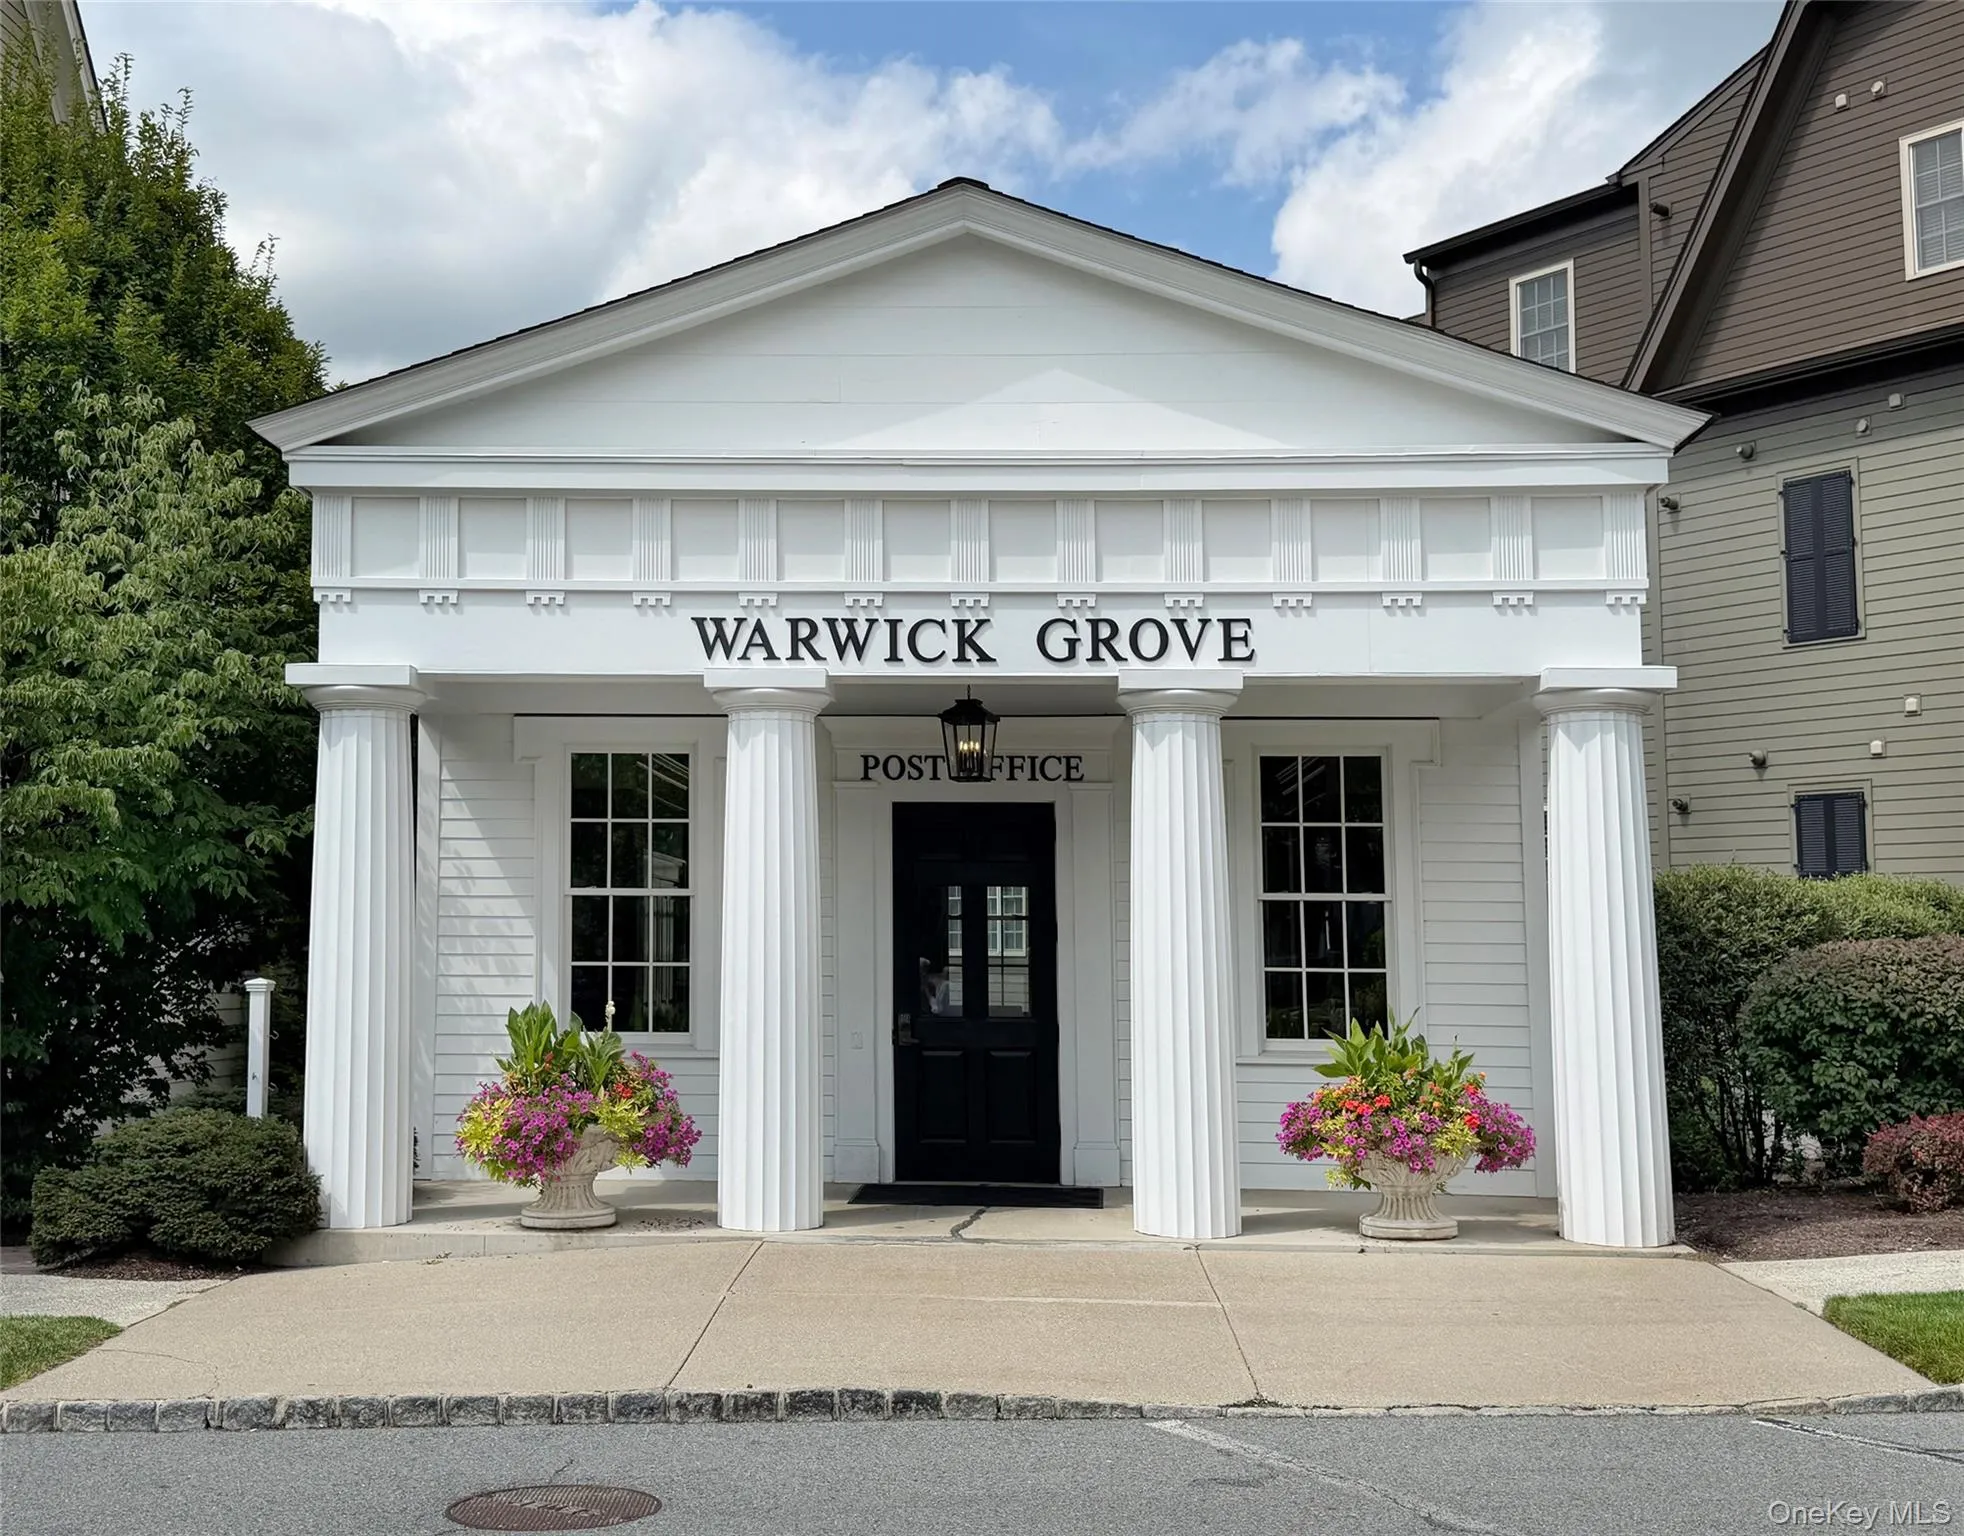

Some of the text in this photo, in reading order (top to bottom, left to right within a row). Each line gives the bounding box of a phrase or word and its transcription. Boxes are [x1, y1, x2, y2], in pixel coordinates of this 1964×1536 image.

[691, 617, 1255, 663] WARWICK GROVE
[860, 754, 1084, 782] POST FFICE
